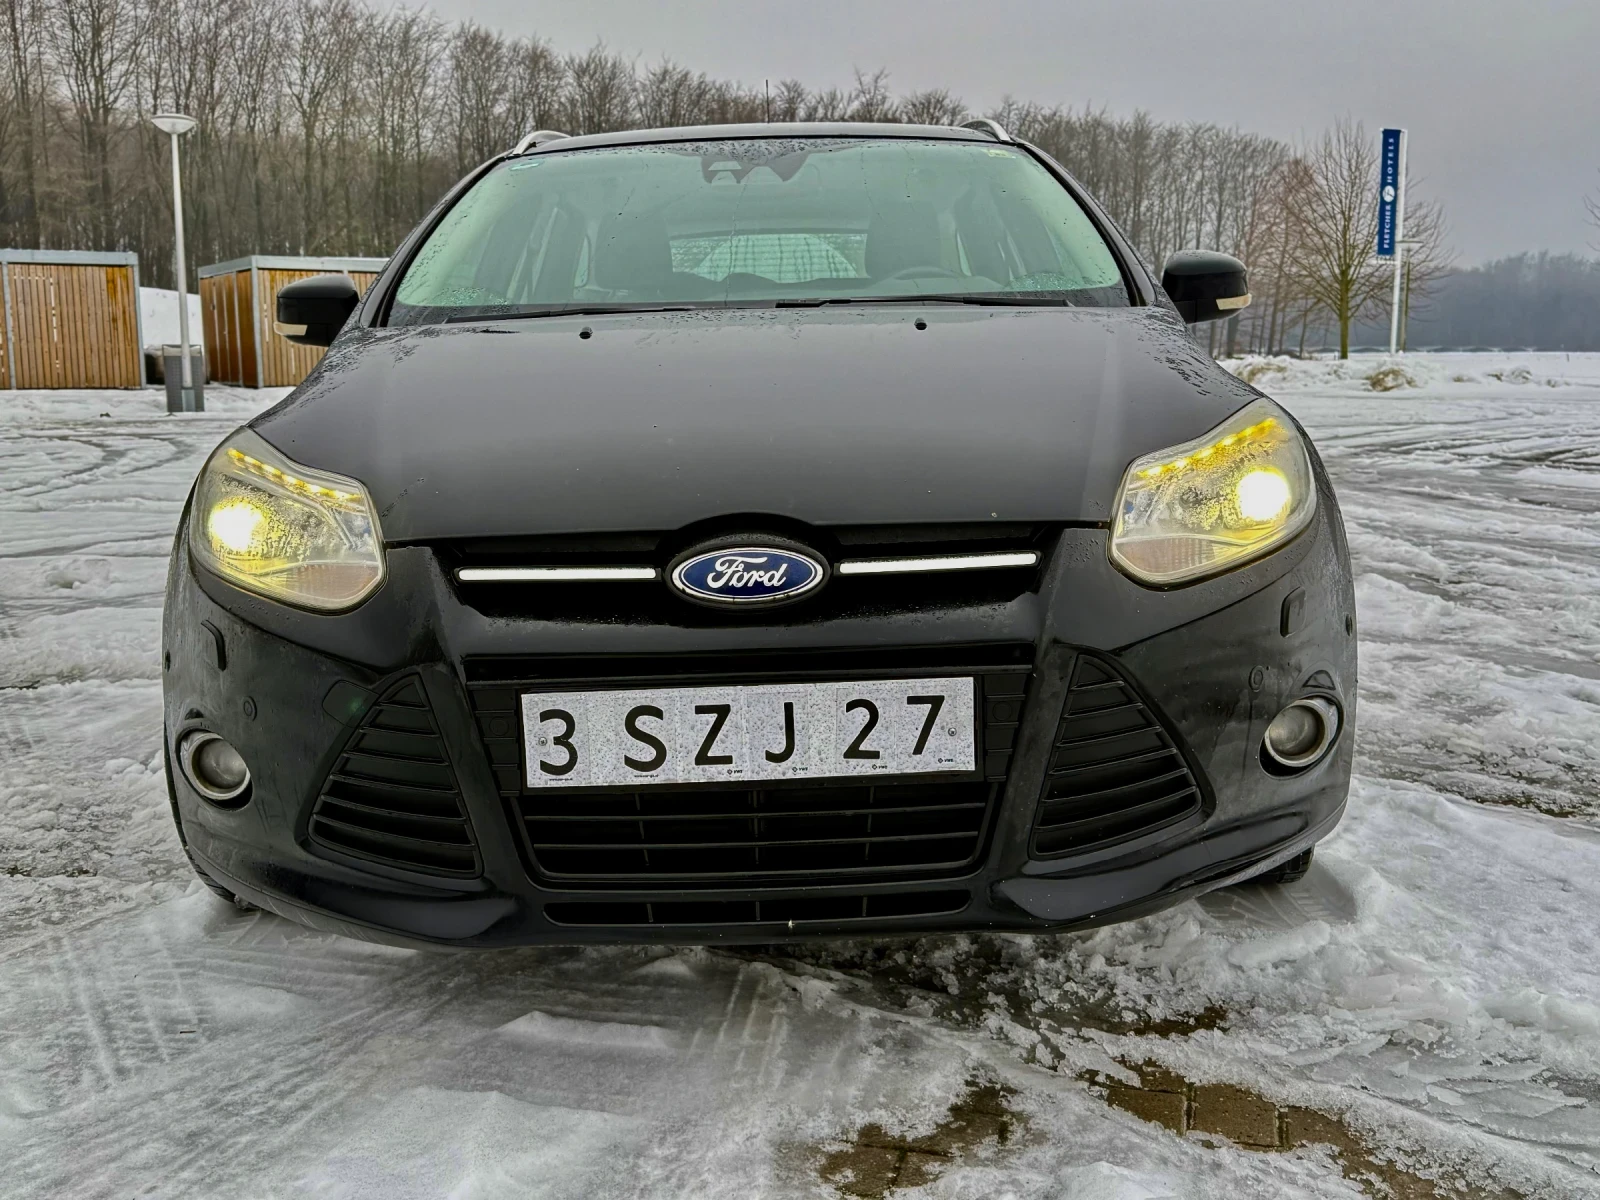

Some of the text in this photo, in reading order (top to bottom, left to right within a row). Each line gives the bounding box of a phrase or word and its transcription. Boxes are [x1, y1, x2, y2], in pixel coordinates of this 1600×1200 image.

[1383, 138, 1395, 249] FLETCHER HOTELS
[706, 556, 788, 589] Ford
[539, 708, 578, 776] 3
[842, 694, 946, 760] 27
